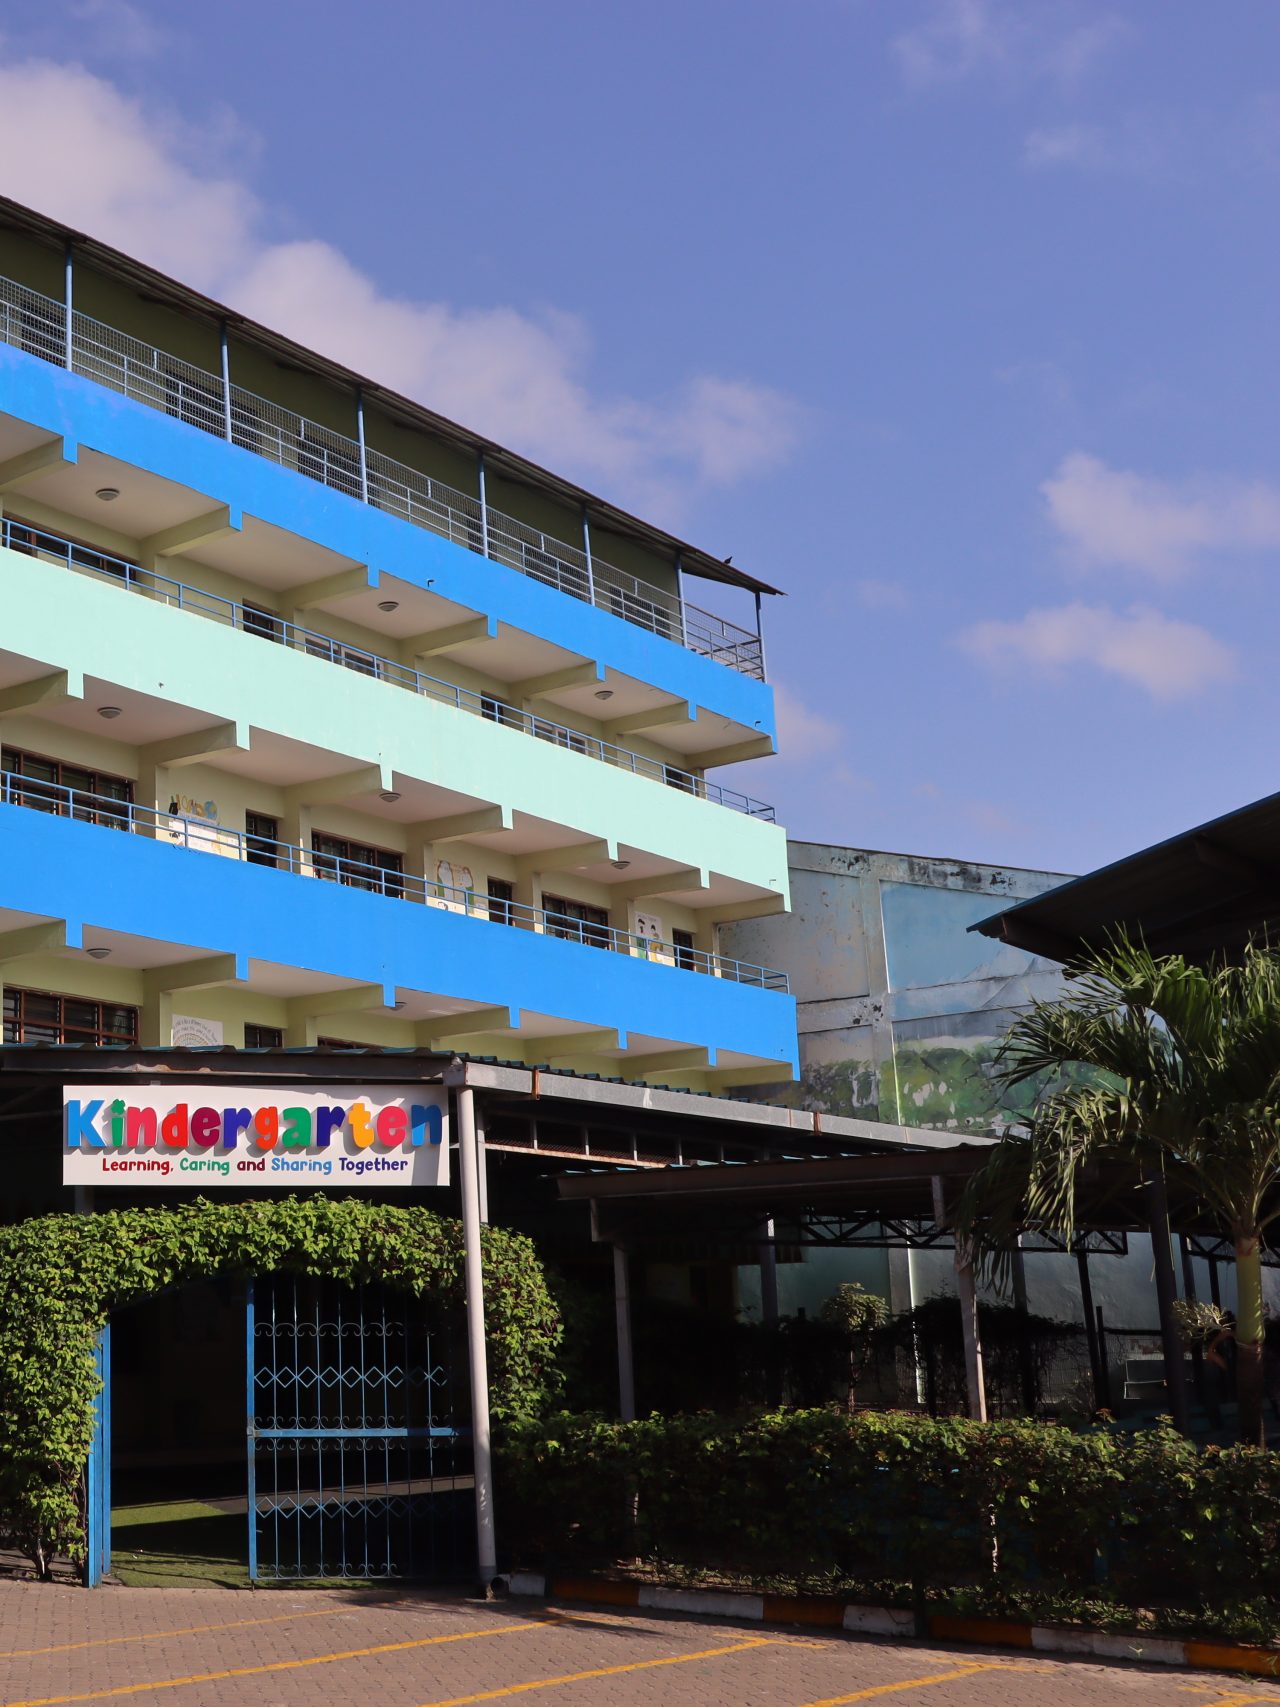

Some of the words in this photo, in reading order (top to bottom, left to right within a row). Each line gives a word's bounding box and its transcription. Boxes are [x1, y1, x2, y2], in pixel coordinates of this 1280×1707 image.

[67, 1099, 442, 1149] Kindergarten
[102, 1158, 174, 1176] Learning,
[180, 1158, 230, 1176] Caring
[237, 1158, 266, 1172] and
[271, 1158, 332, 1176] Sharing
[339, 1158, 408, 1175] Together
